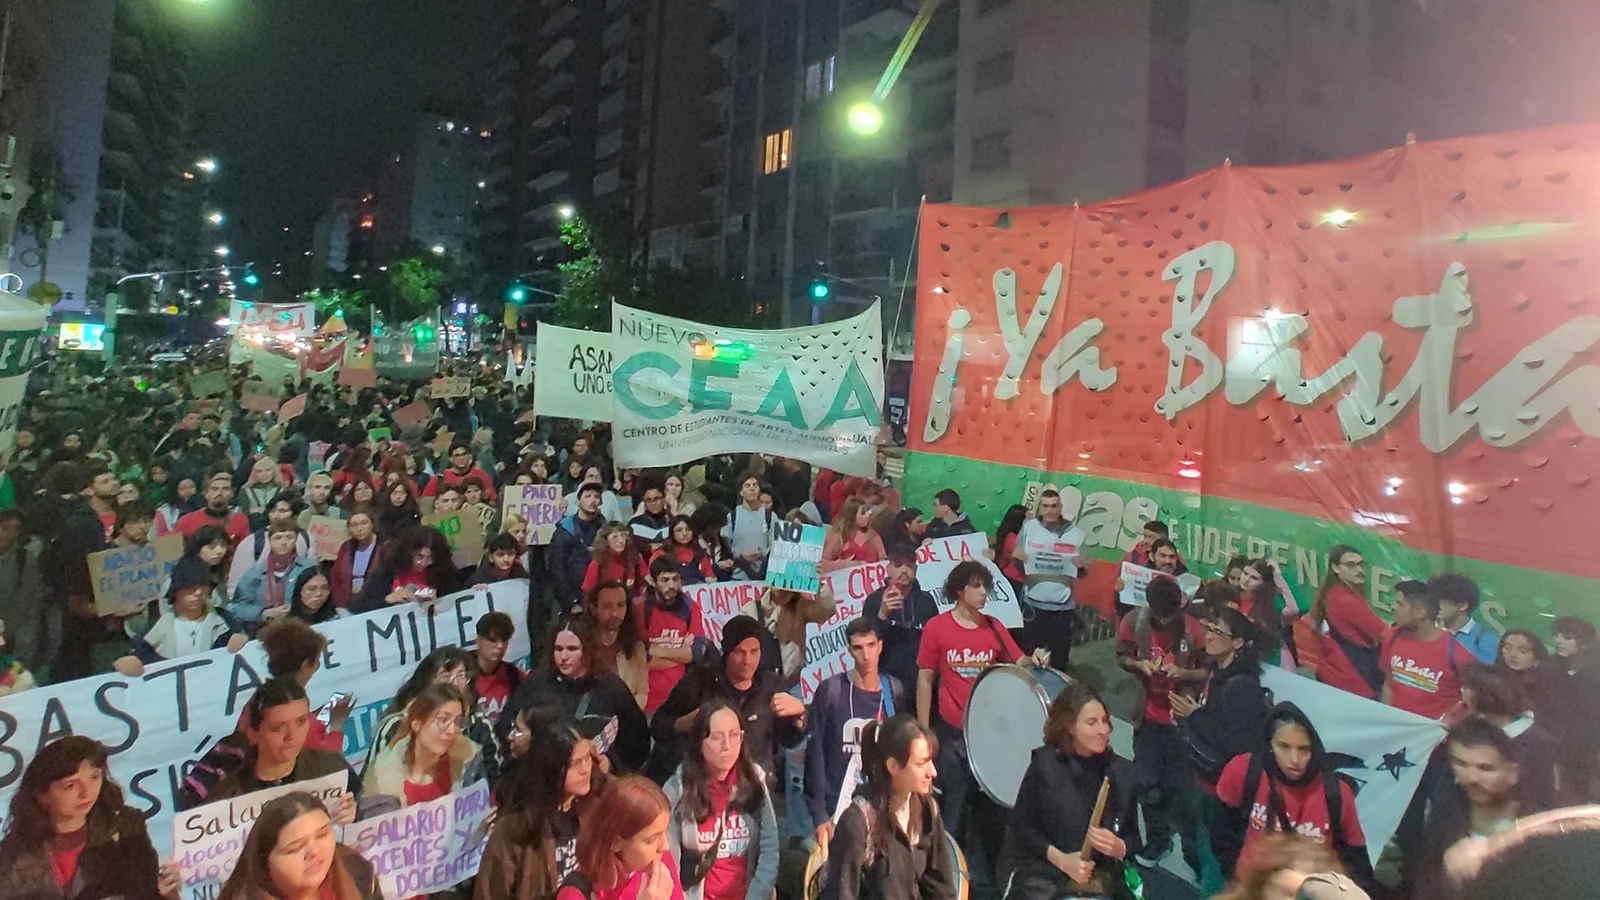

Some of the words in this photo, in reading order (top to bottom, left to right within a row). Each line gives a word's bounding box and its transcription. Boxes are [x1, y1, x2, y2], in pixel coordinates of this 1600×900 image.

[619, 318, 707, 349] NUEVO
[613, 351, 882, 431] CEAA
[623, 426, 667, 438] CENTRO
[671, 424, 682, 434] DE
[685, 415, 738, 432] ESTUDIANTES
[758, 423, 792, 434] ARTES
[522, 485, 557, 500] PARO
[773, 521, 803, 543] NO
[916, 542, 942, 565] DE
[944, 540, 975, 562] LA
[0, 655, 262, 788] BASTA
[357, 804, 447, 850] SALARIO
[454, 821, 473, 852] Y
